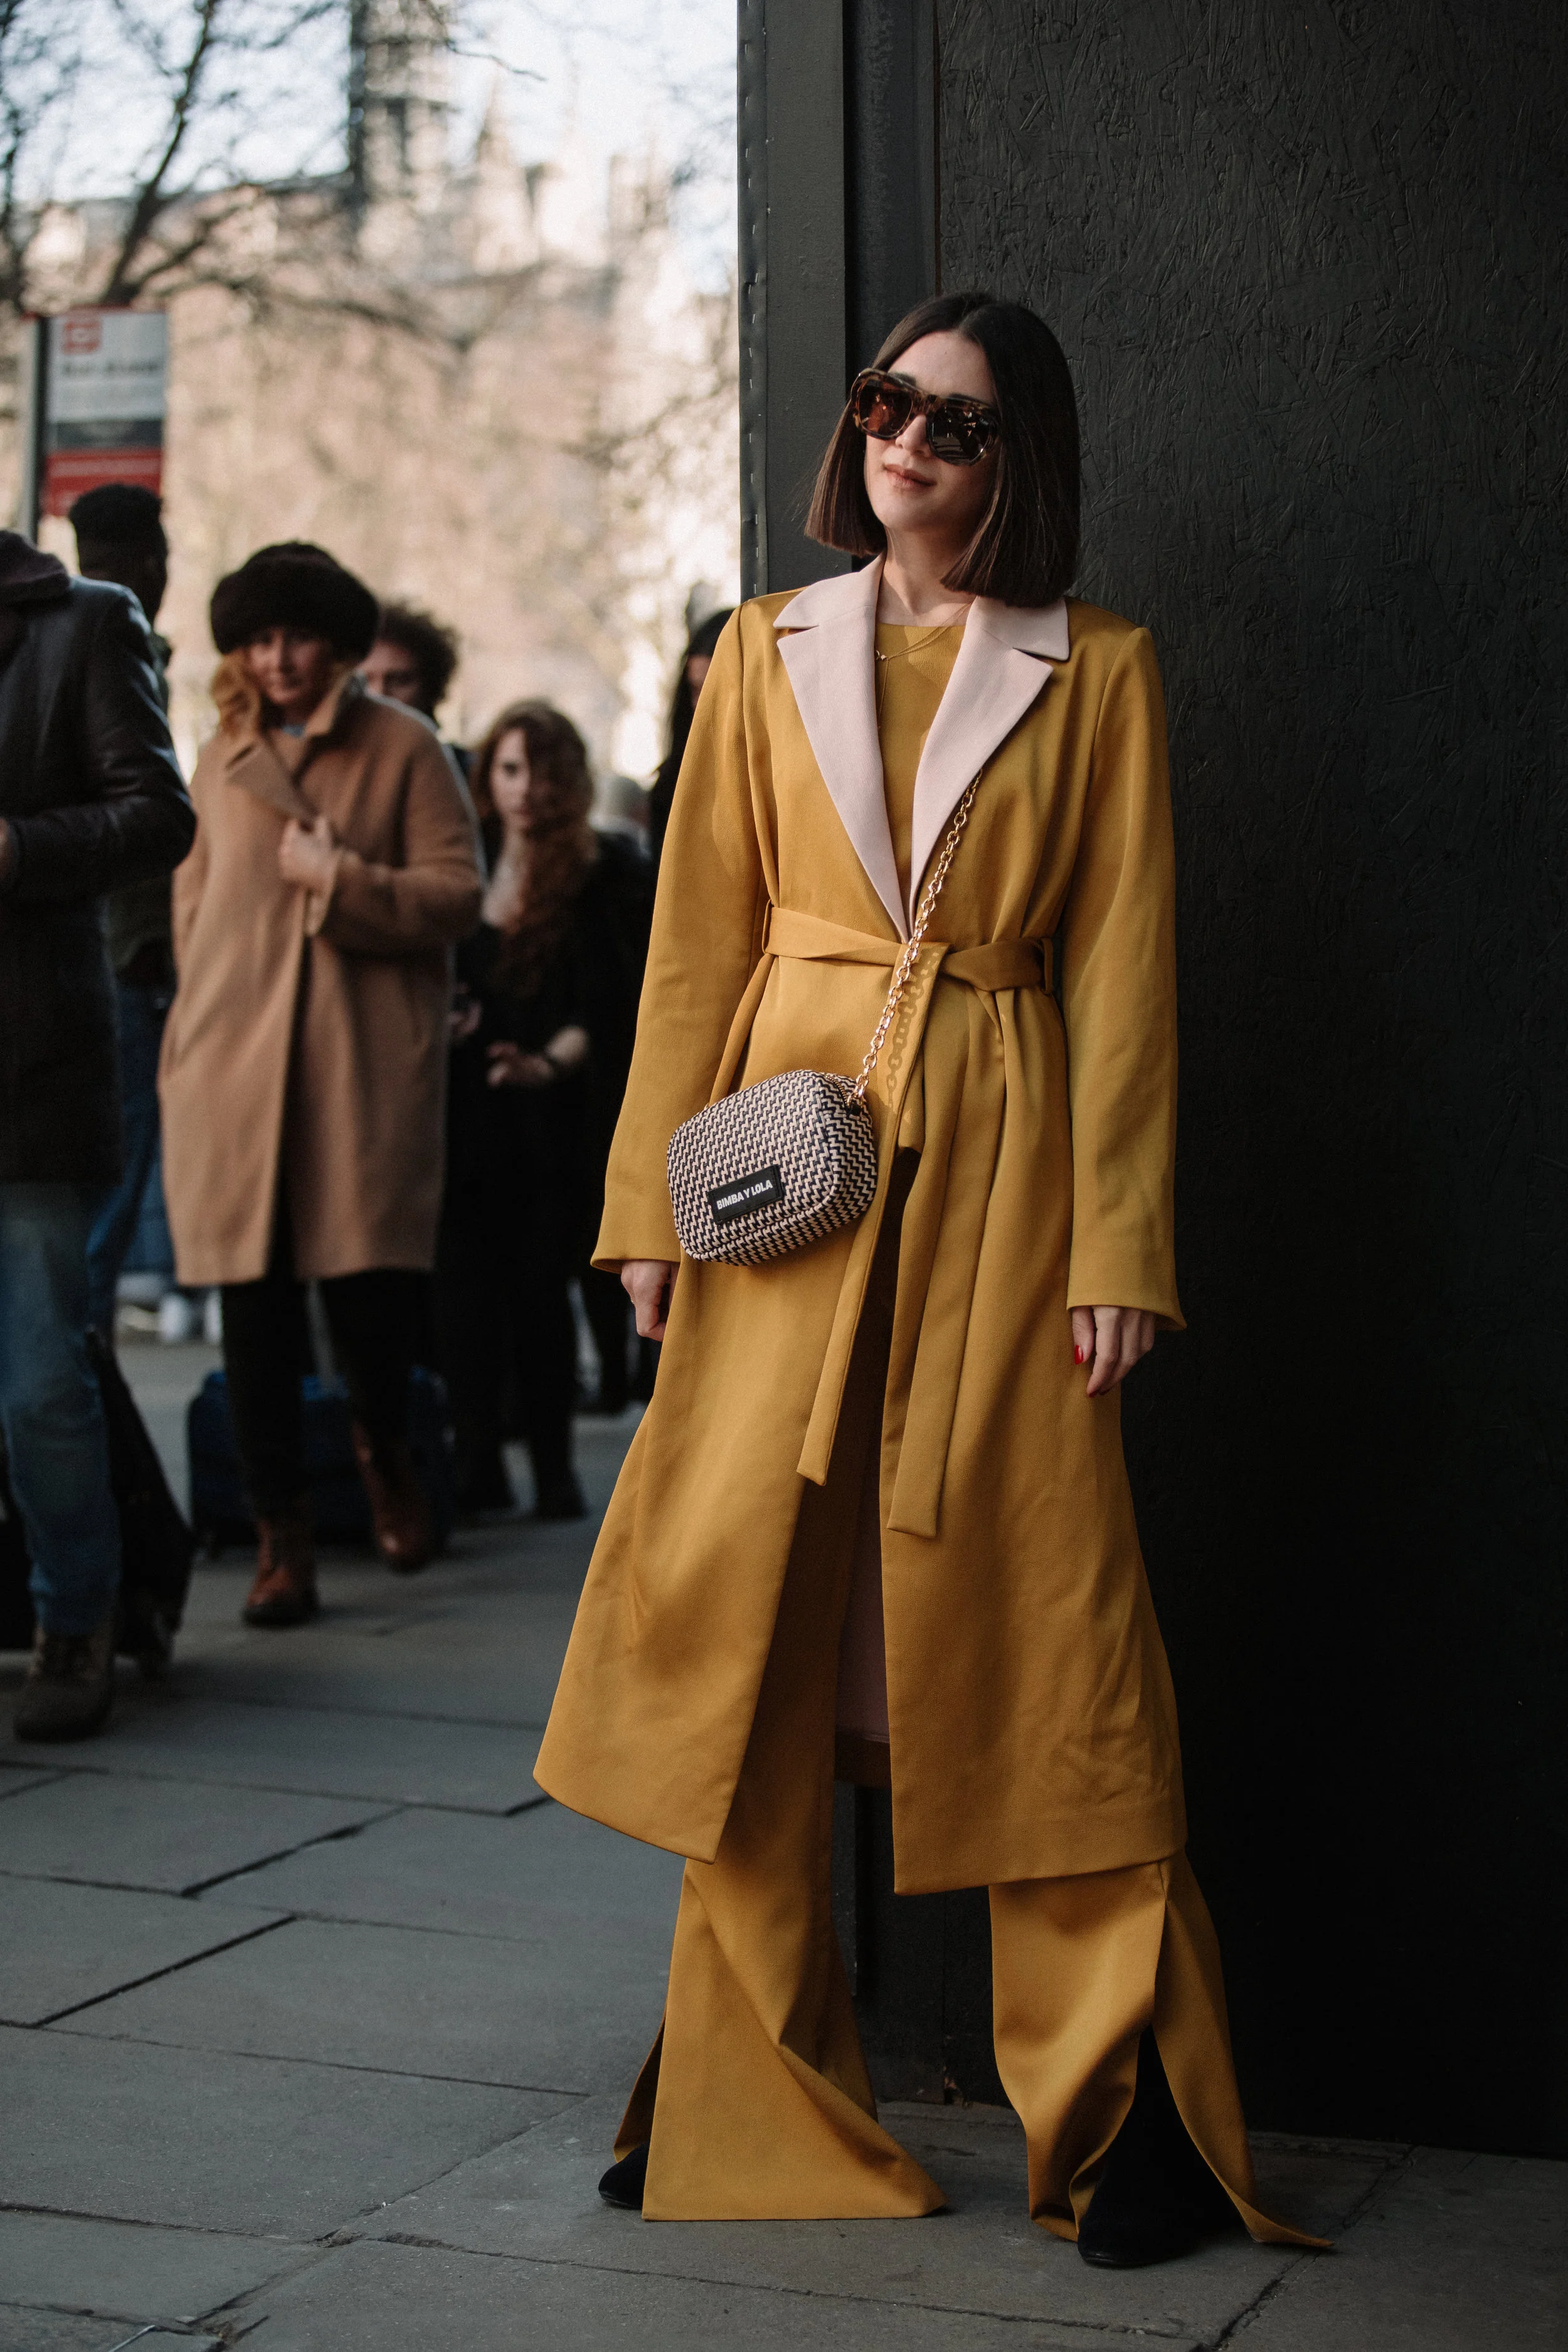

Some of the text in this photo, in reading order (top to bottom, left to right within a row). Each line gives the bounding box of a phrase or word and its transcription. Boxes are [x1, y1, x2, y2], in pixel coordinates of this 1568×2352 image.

[717, 1180, 773, 1210] BIMBA Y LOLA
